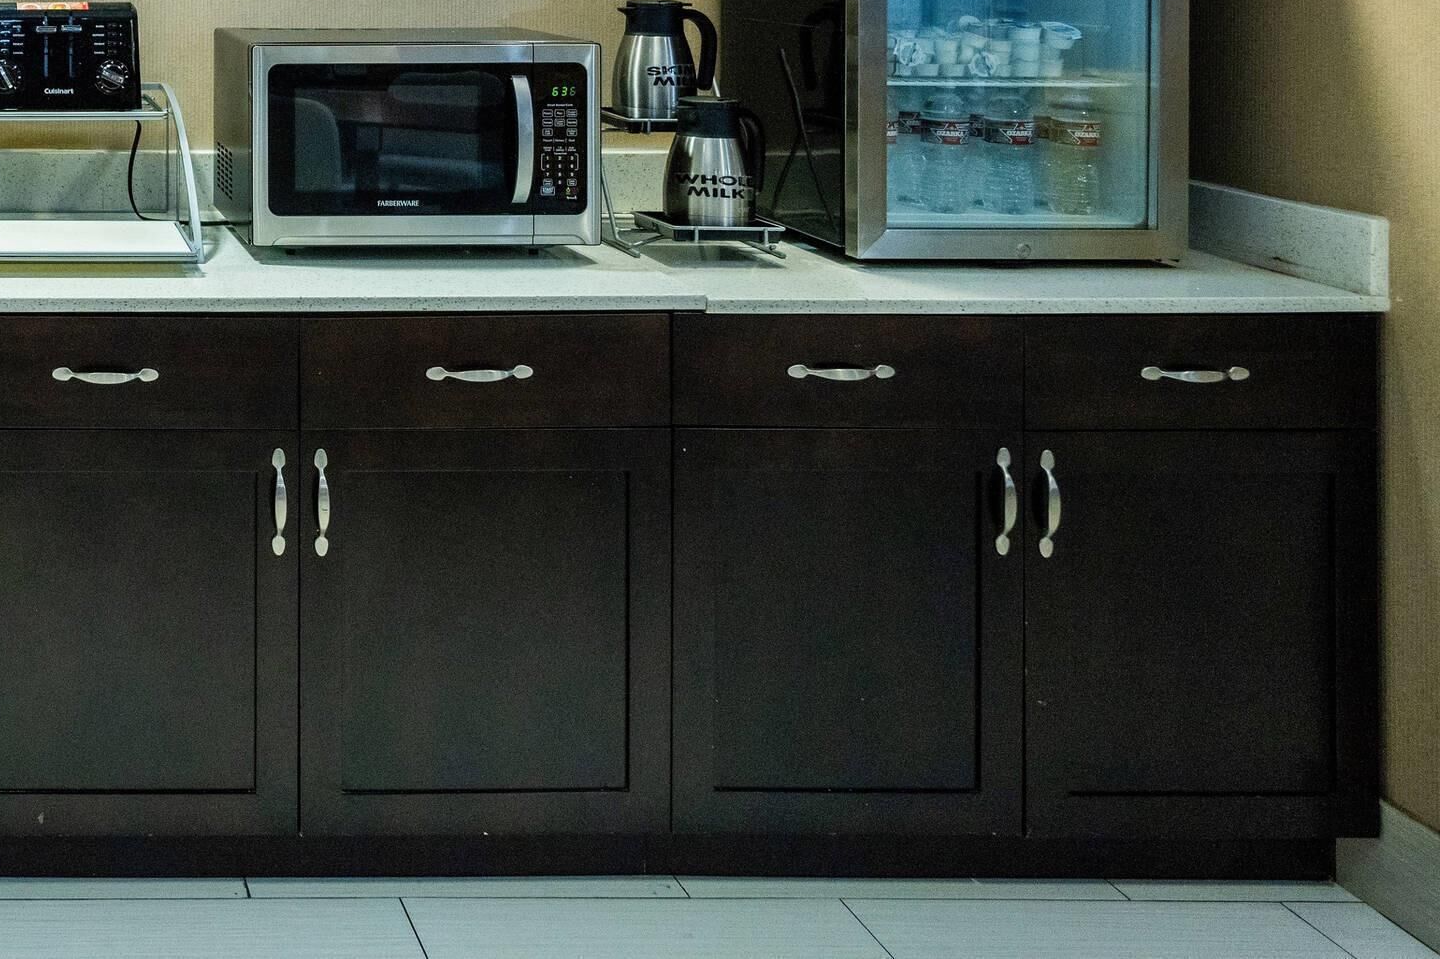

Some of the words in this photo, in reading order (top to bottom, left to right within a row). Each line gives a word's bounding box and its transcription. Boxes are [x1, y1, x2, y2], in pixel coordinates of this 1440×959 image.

[43, 87, 75, 95] Cuisinart
[677, 174, 753, 188] WHOLE
[687, 186, 745, 199] MILK
